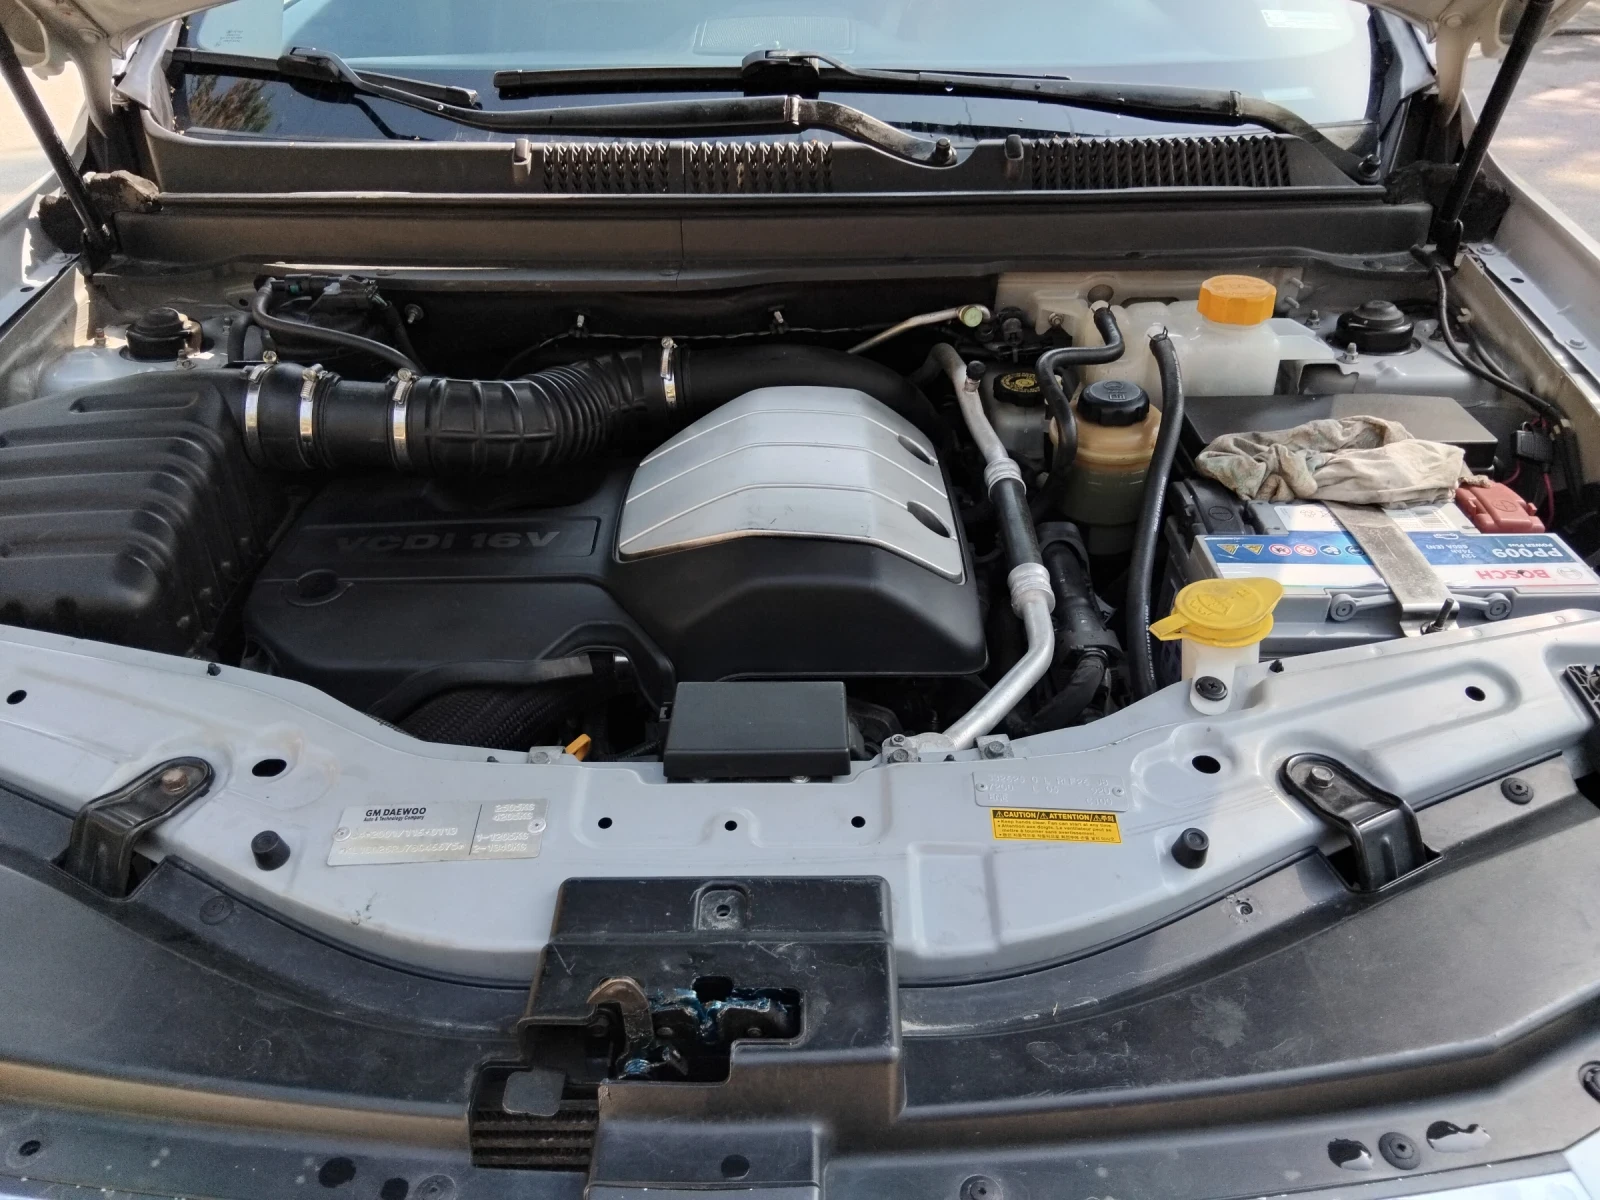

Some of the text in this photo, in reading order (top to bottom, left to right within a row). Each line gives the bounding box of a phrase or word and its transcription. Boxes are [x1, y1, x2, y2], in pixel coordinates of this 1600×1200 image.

[337, 531, 561, 551] VCDI 16V
[1491, 548, 1564, 558] PP009
[1475, 568, 1553, 580] BOSCH
[365, 807, 427, 817] GM DAEWOO
